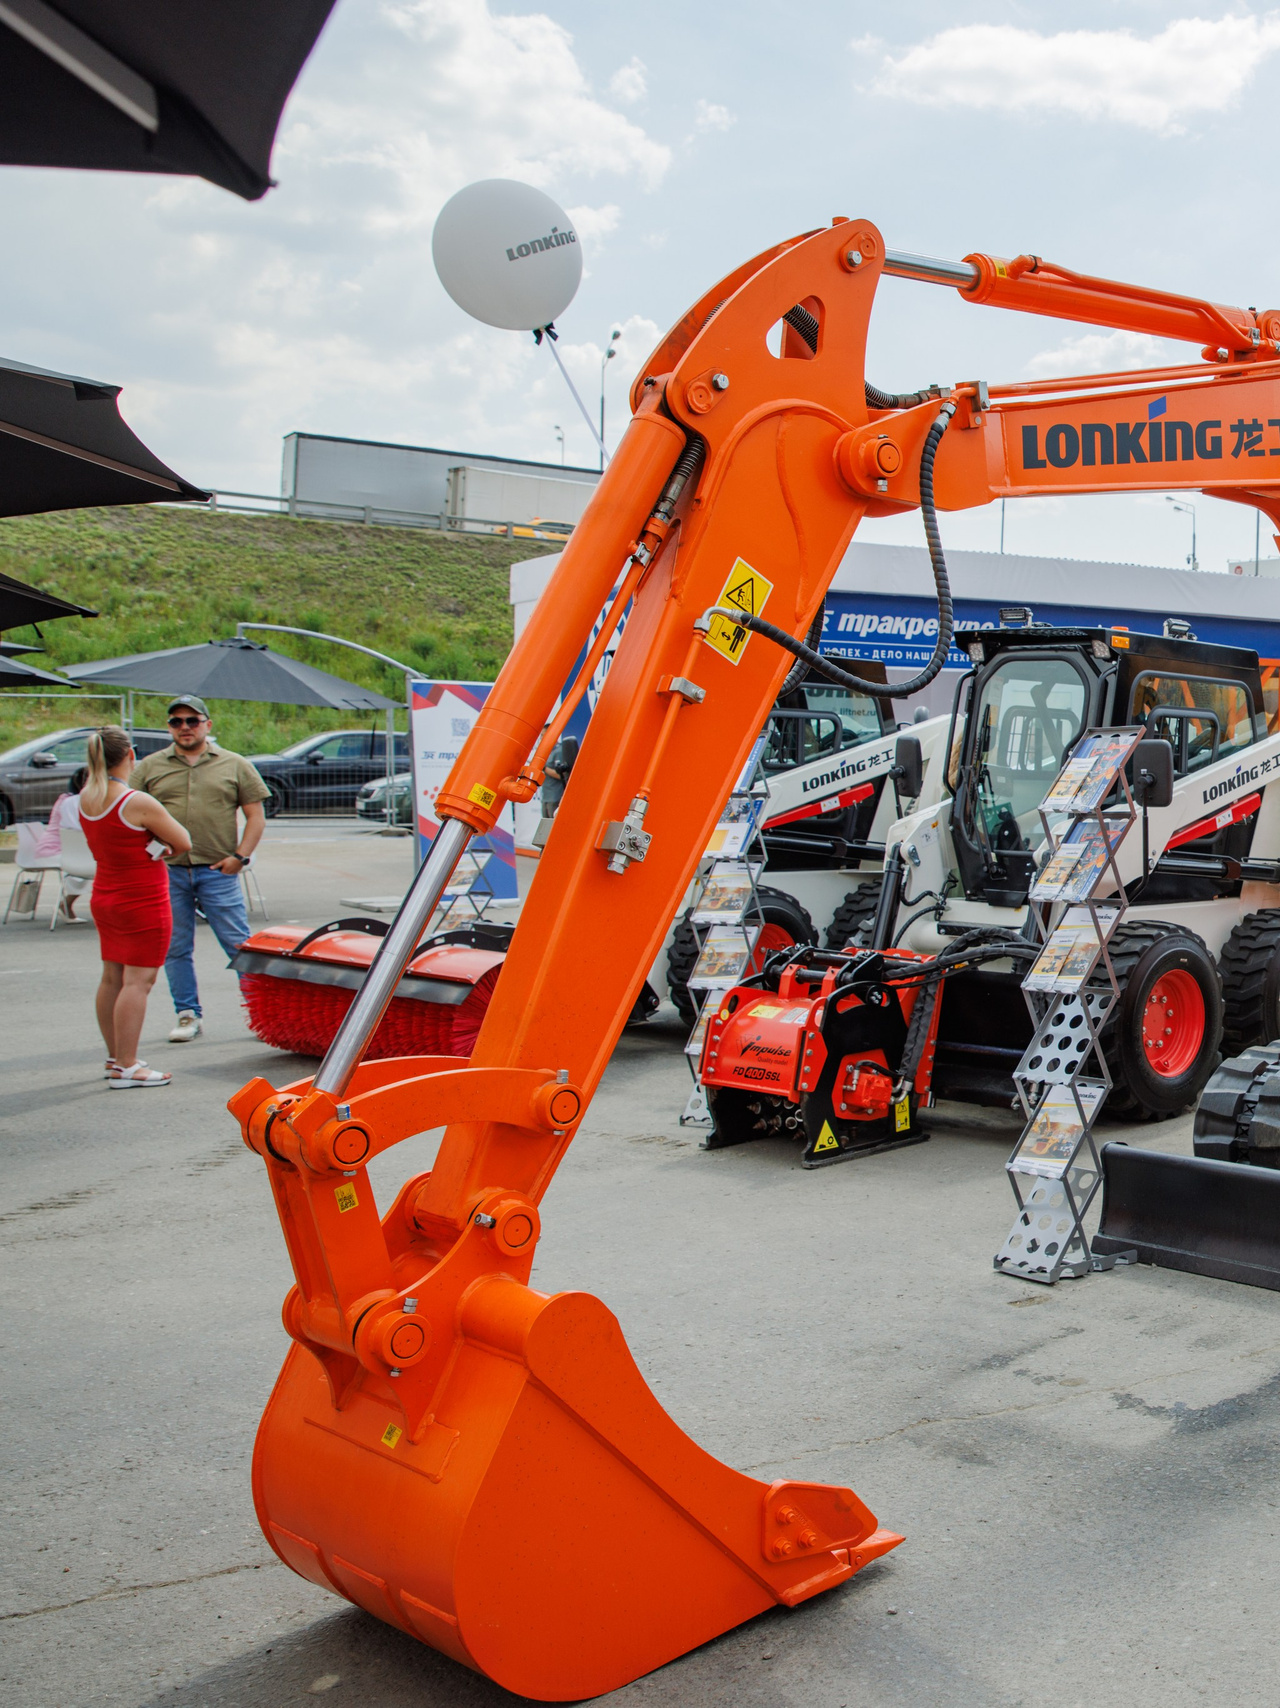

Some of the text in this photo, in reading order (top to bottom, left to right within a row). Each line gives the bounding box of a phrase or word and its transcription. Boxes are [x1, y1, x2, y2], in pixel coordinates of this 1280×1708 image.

[505, 226, 576, 262] LONKING
[1021, 395, 1223, 470] LONKING
[872, 649, 903, 659] ДЕЛО
[802, 749, 894, 792] LONKING 龙工
[1202, 765, 1259, 804] LONKING
[732, 1066, 781, 1081] FD 400 SSL
